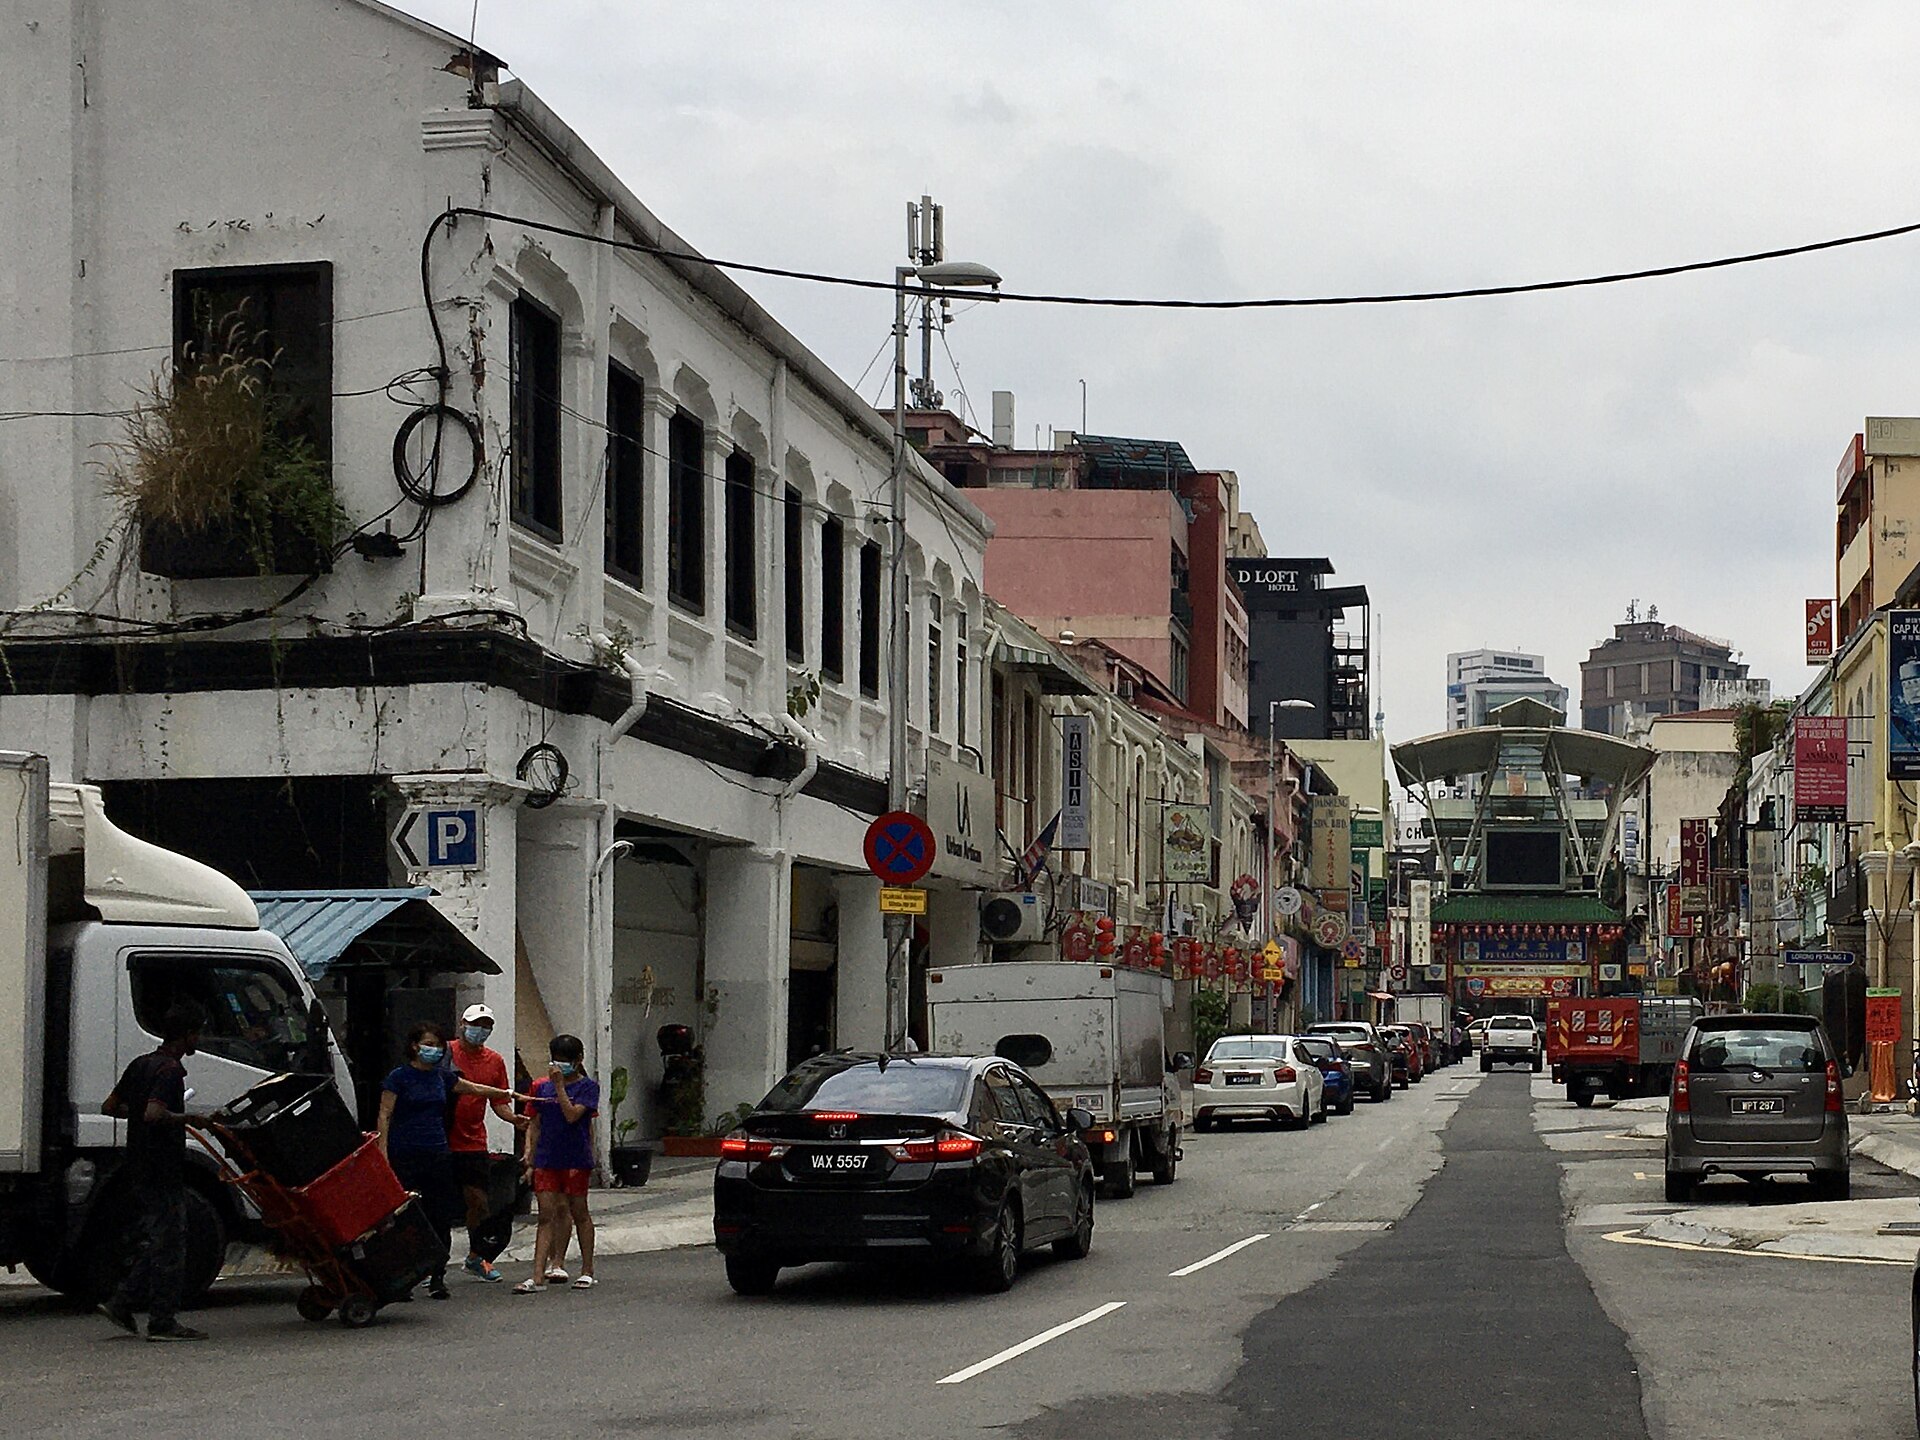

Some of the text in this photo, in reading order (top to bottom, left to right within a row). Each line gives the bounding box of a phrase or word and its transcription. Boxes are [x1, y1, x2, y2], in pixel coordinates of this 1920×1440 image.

[1238, 570, 1299, 583] D LOFT
[1268, 584, 1298, 592] HOTEL
[1807, 605, 1832, 636] OYO
[1893, 624, 1920, 634] CAP K
[1808, 648, 1831, 656] HOTEL
[1070, 733, 1081, 806] ASIA
[437, 816, 467, 860] P
[1694, 820, 1707, 885] HOTEL
[1815, 953, 1842, 961] PETALING
[1742, 1101, 1758, 1111] WPT
[811, 1155, 870, 1169] VAX 5557
